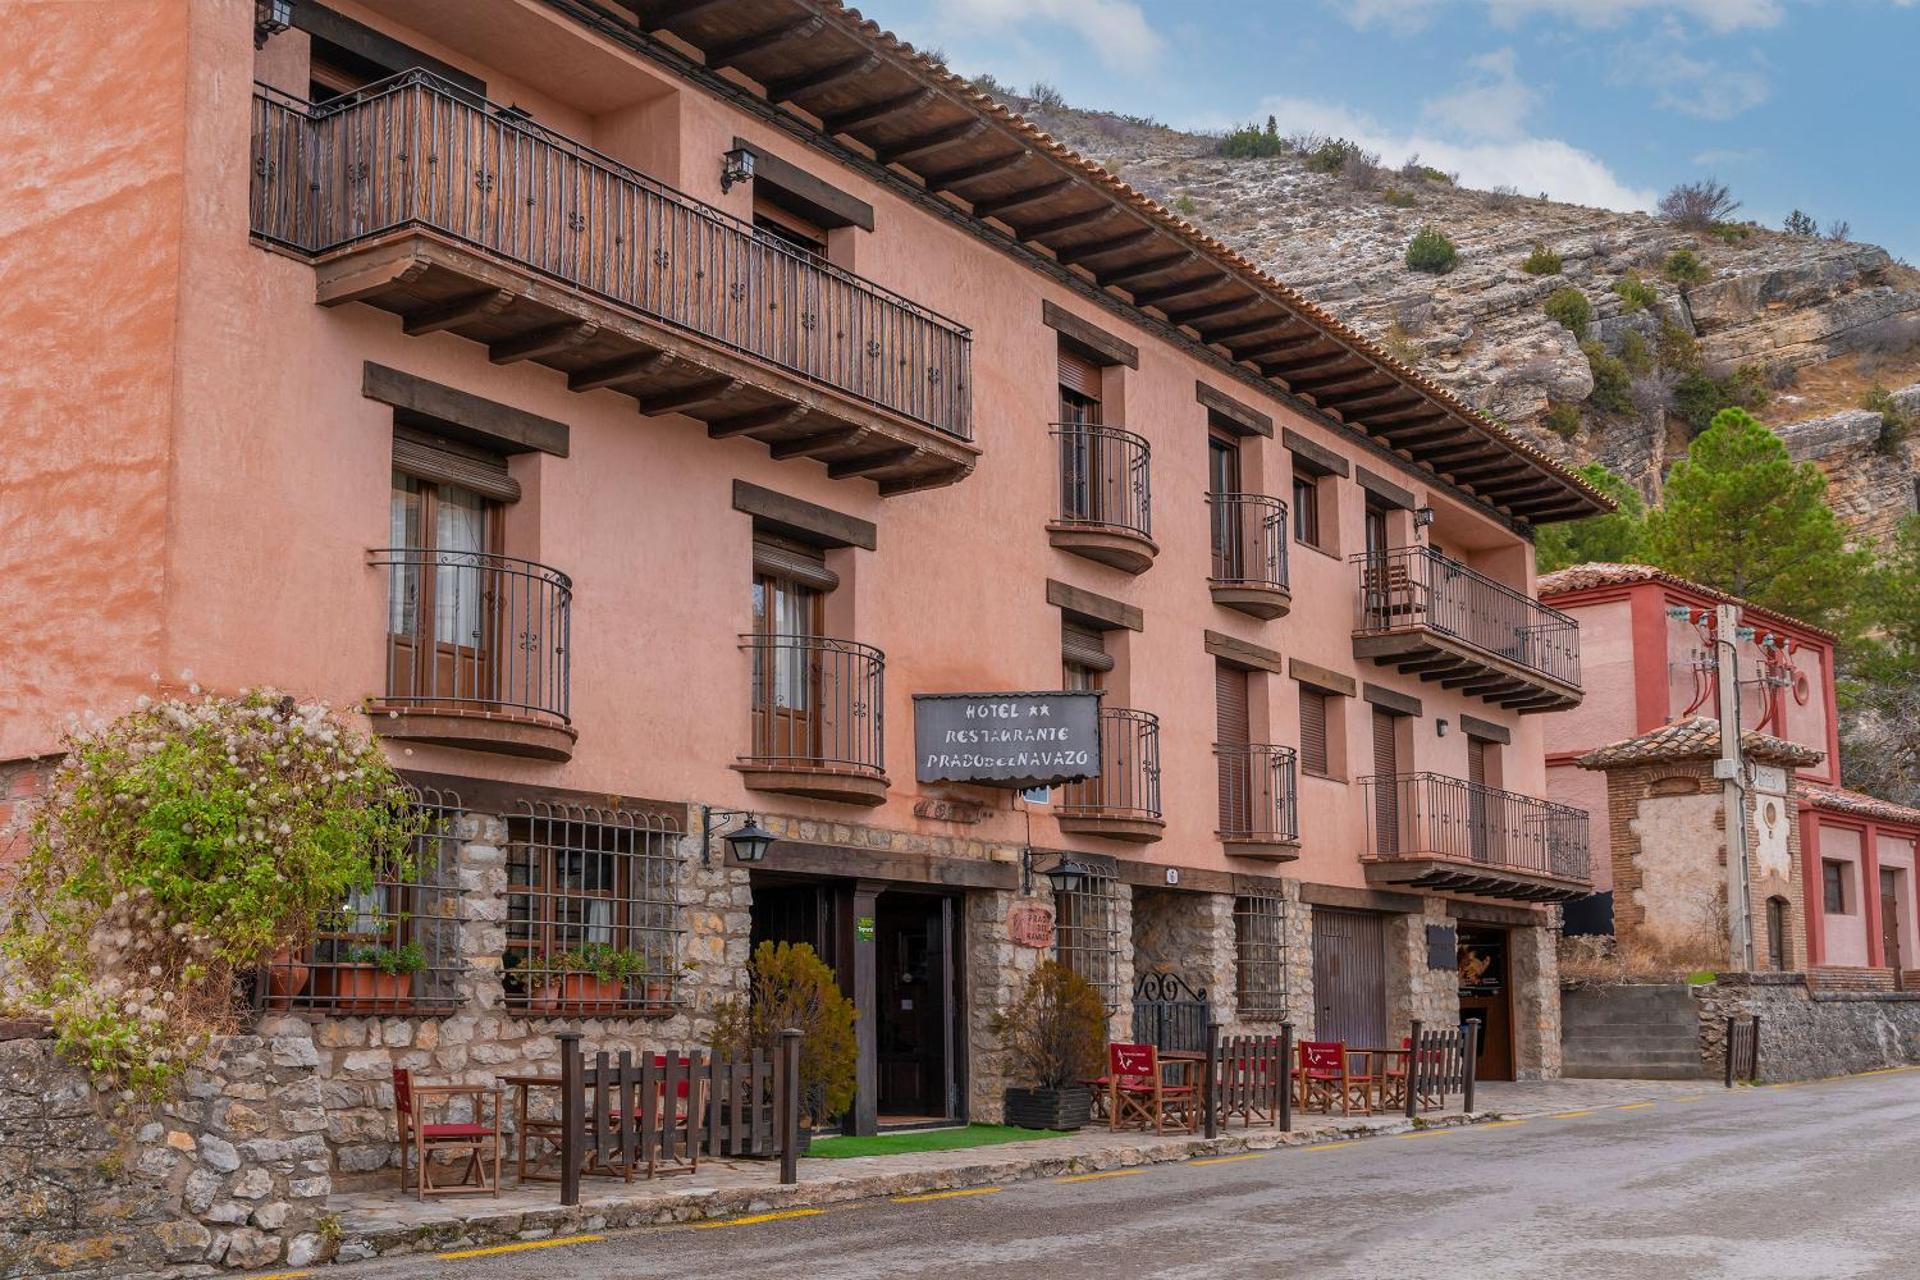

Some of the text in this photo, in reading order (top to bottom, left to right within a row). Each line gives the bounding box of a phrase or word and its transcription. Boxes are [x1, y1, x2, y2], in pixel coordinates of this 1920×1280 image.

[966, 703, 1019, 719] HOTEL
[945, 727, 1069, 744] RESTAURANTE
[927, 753, 984, 768] PRADO
[1016, 750, 1088, 767] NAVAZO
